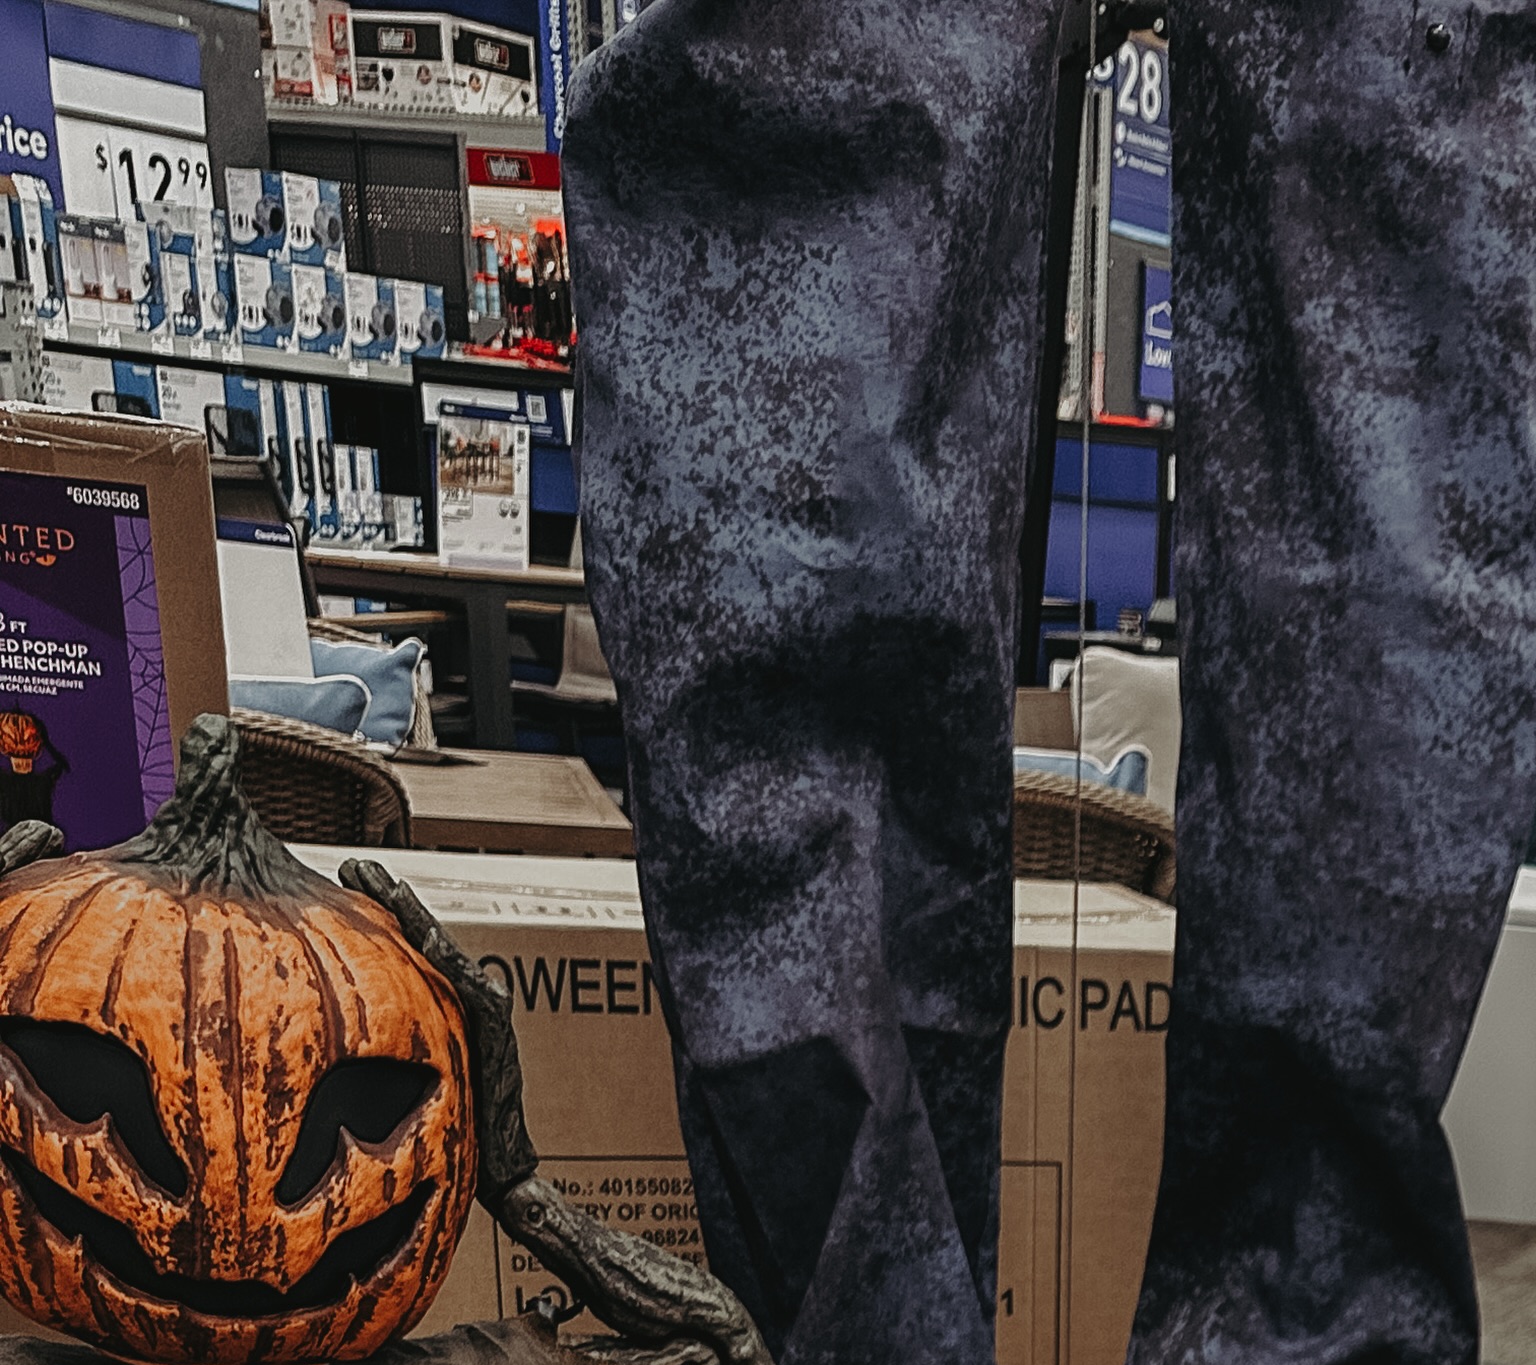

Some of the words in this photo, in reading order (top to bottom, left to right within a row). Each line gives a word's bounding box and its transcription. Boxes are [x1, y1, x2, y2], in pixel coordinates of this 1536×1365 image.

[1117, 40, 1162, 124] 28
[9, 620, 27, 634] FT
[22, 639, 89, 659] POP-UP
[0, 654, 101, 677] HENCHMAN
[617, 1202, 648, 1222] OF
